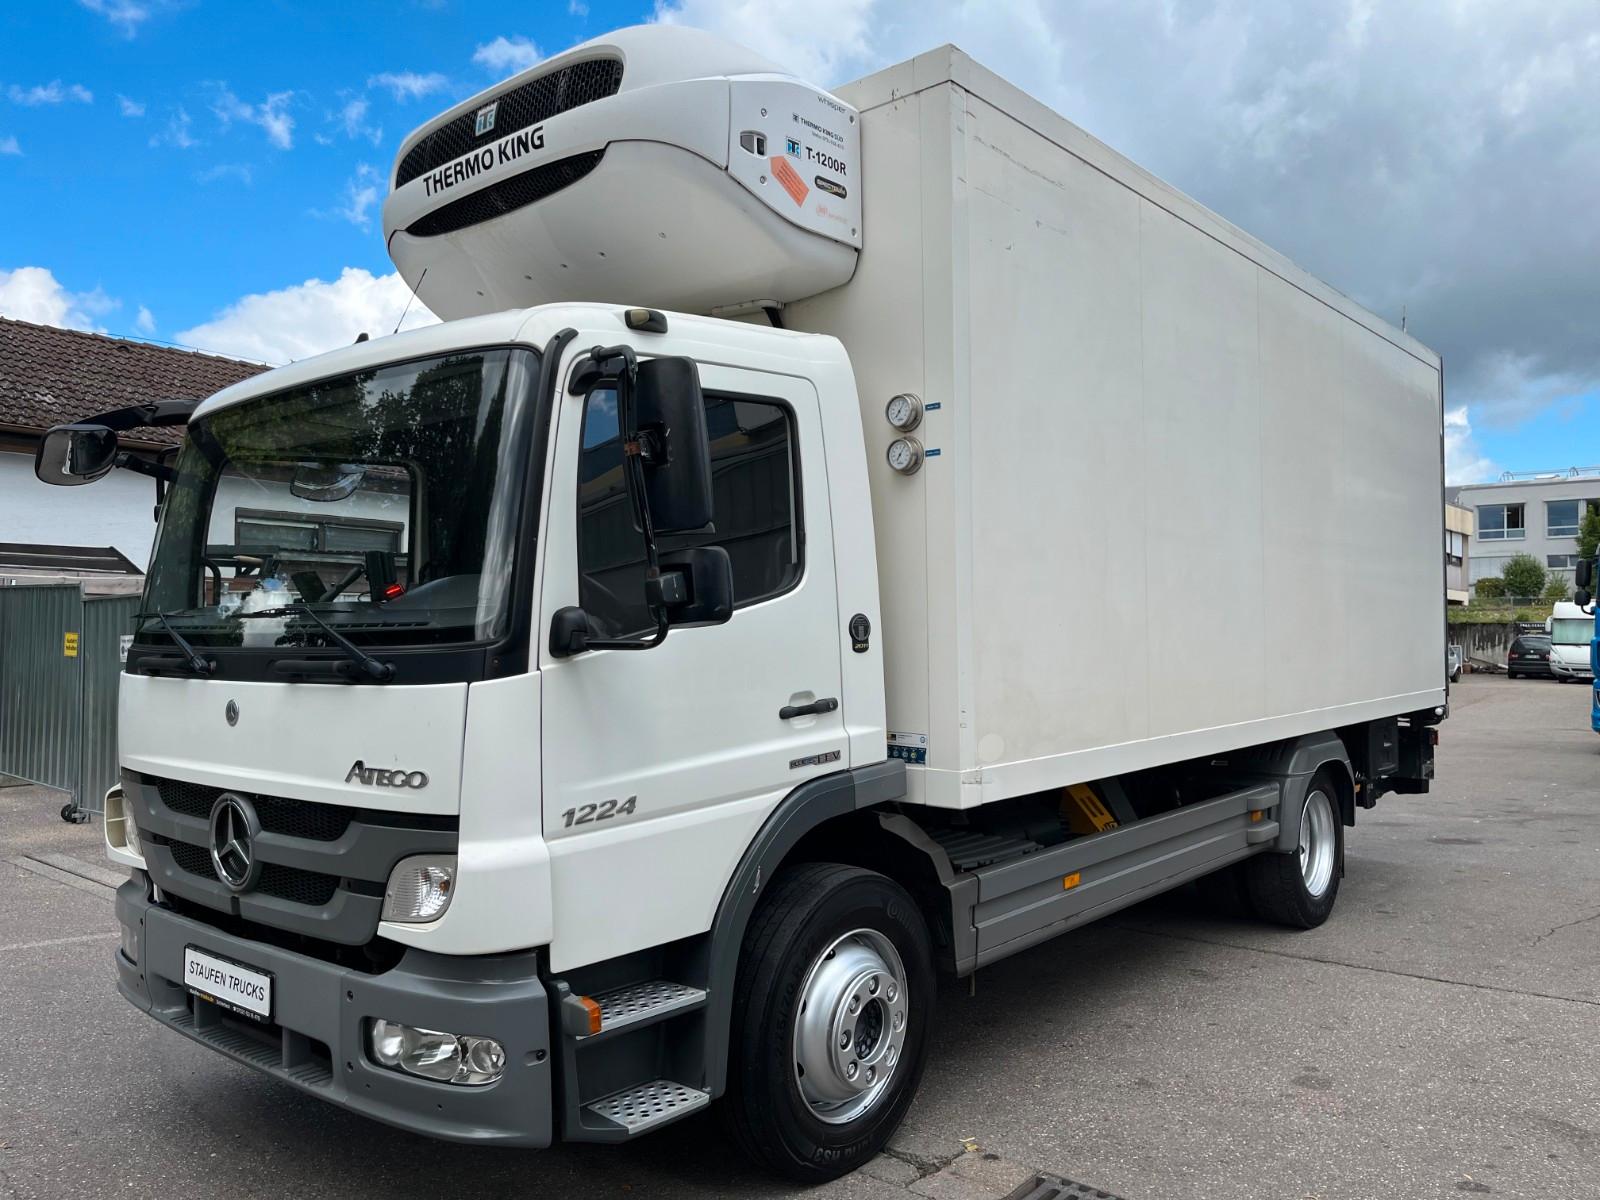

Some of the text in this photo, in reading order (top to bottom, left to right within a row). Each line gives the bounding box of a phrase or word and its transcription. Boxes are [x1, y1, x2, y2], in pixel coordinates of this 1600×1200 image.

[422, 125, 545, 197] THERMO KING
[805, 145, 847, 177] T-1200R
[561, 795, 637, 828] 1224
[189, 960, 227, 987] STAUFEN
[228, 975, 265, 1001] TRUCKS
